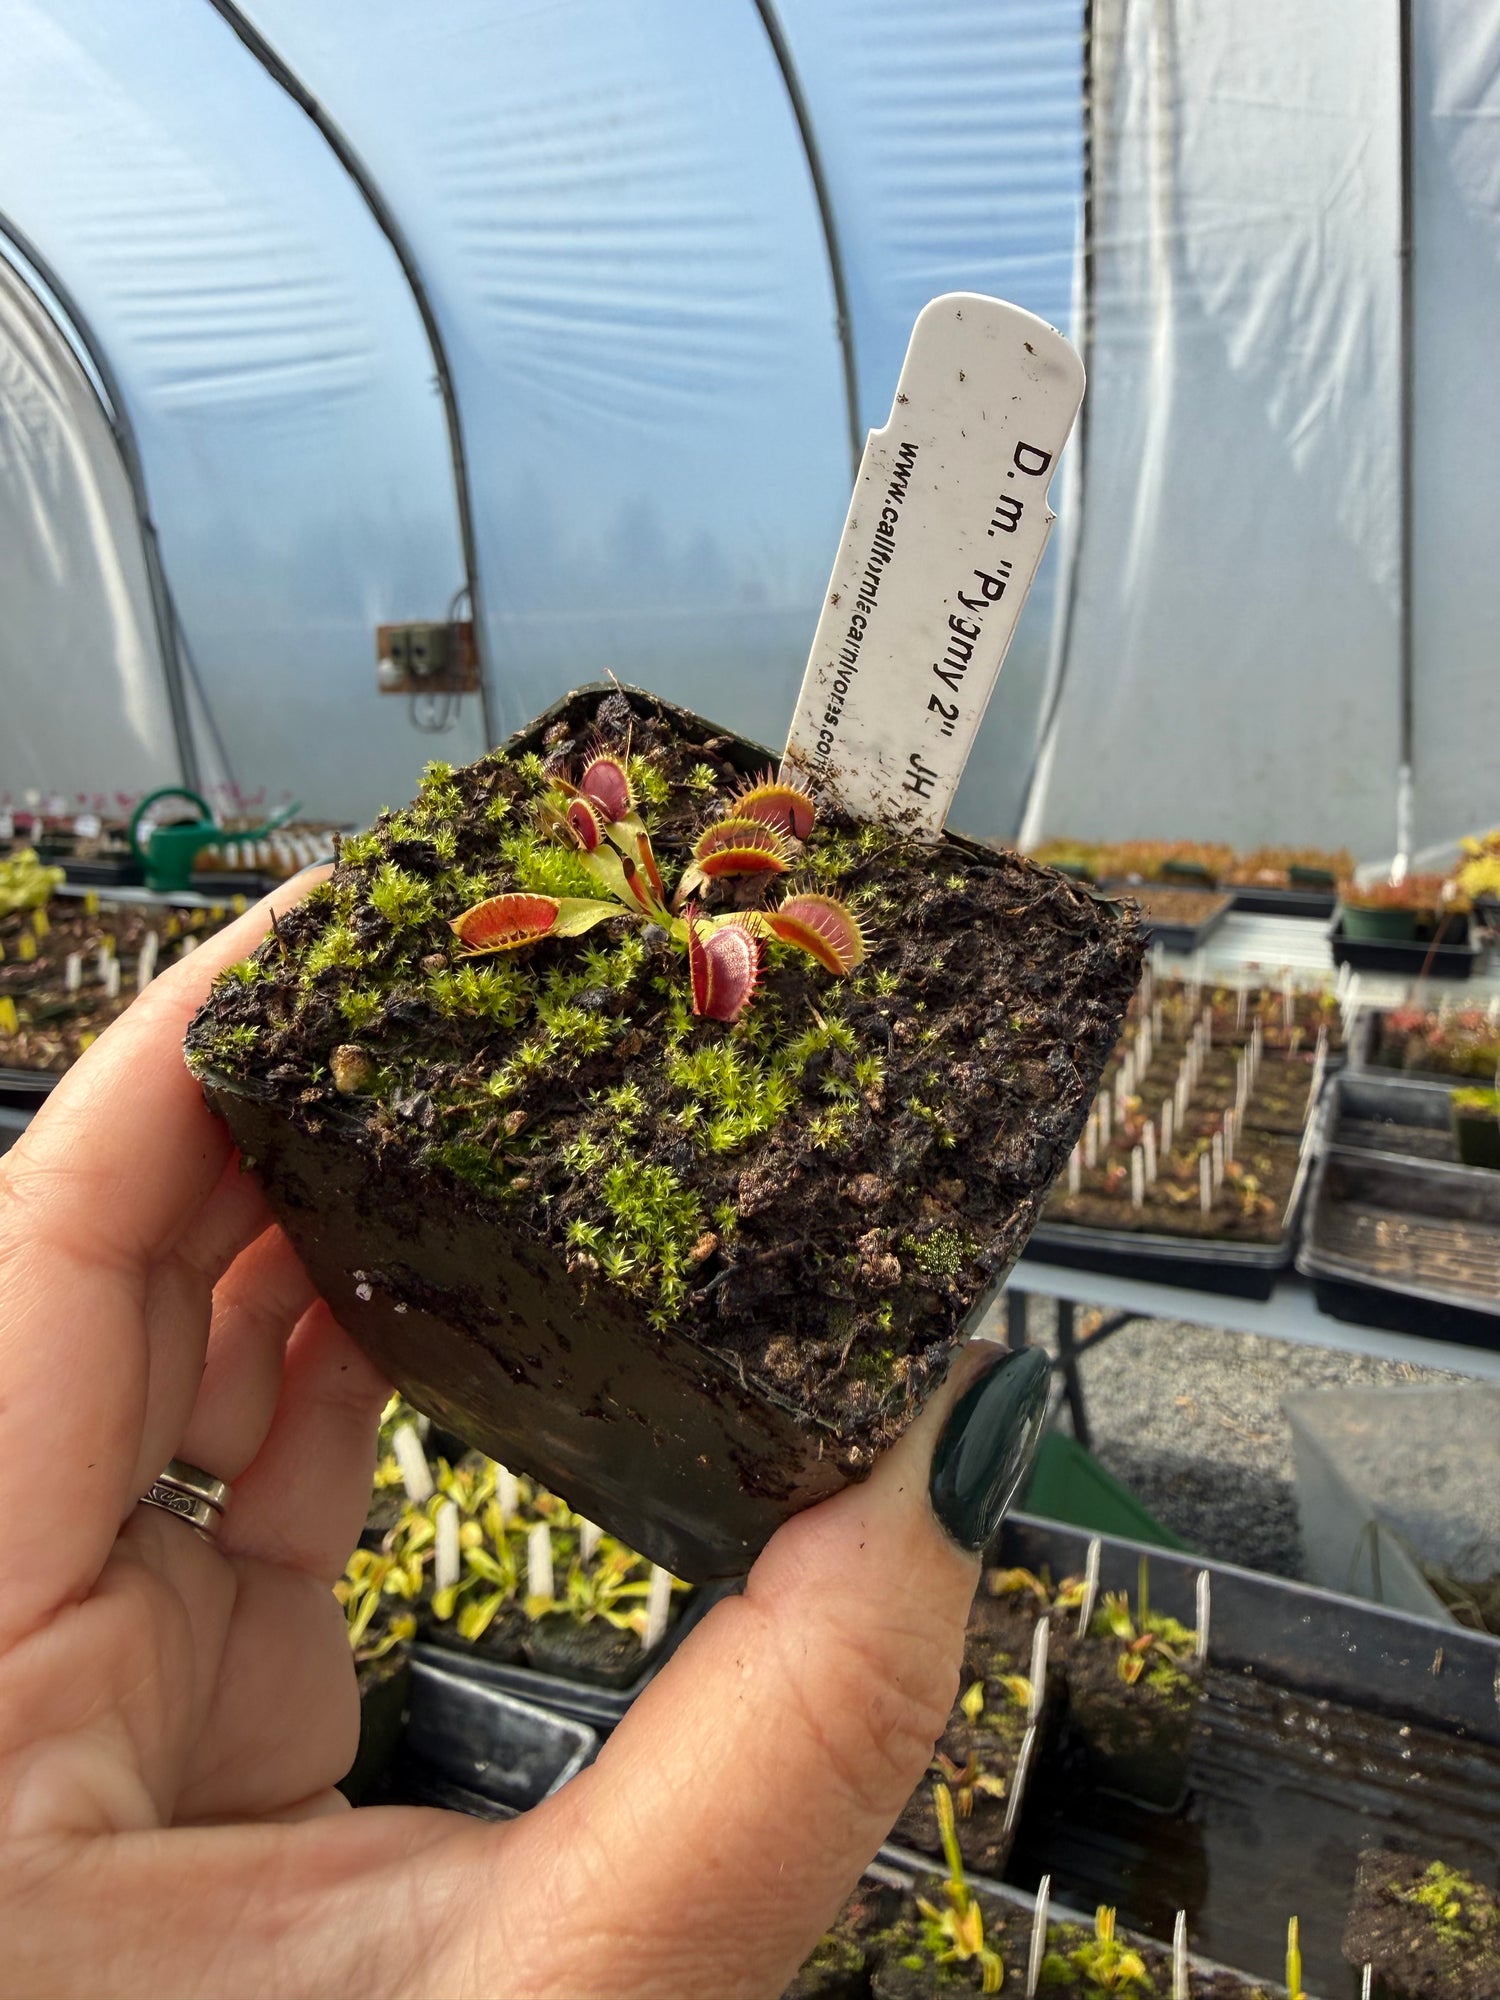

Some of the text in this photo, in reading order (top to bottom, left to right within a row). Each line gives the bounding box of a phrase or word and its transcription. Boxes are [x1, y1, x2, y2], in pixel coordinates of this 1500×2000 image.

[901, 440, 1053, 800] D. m. "Pygmy 2" JH
